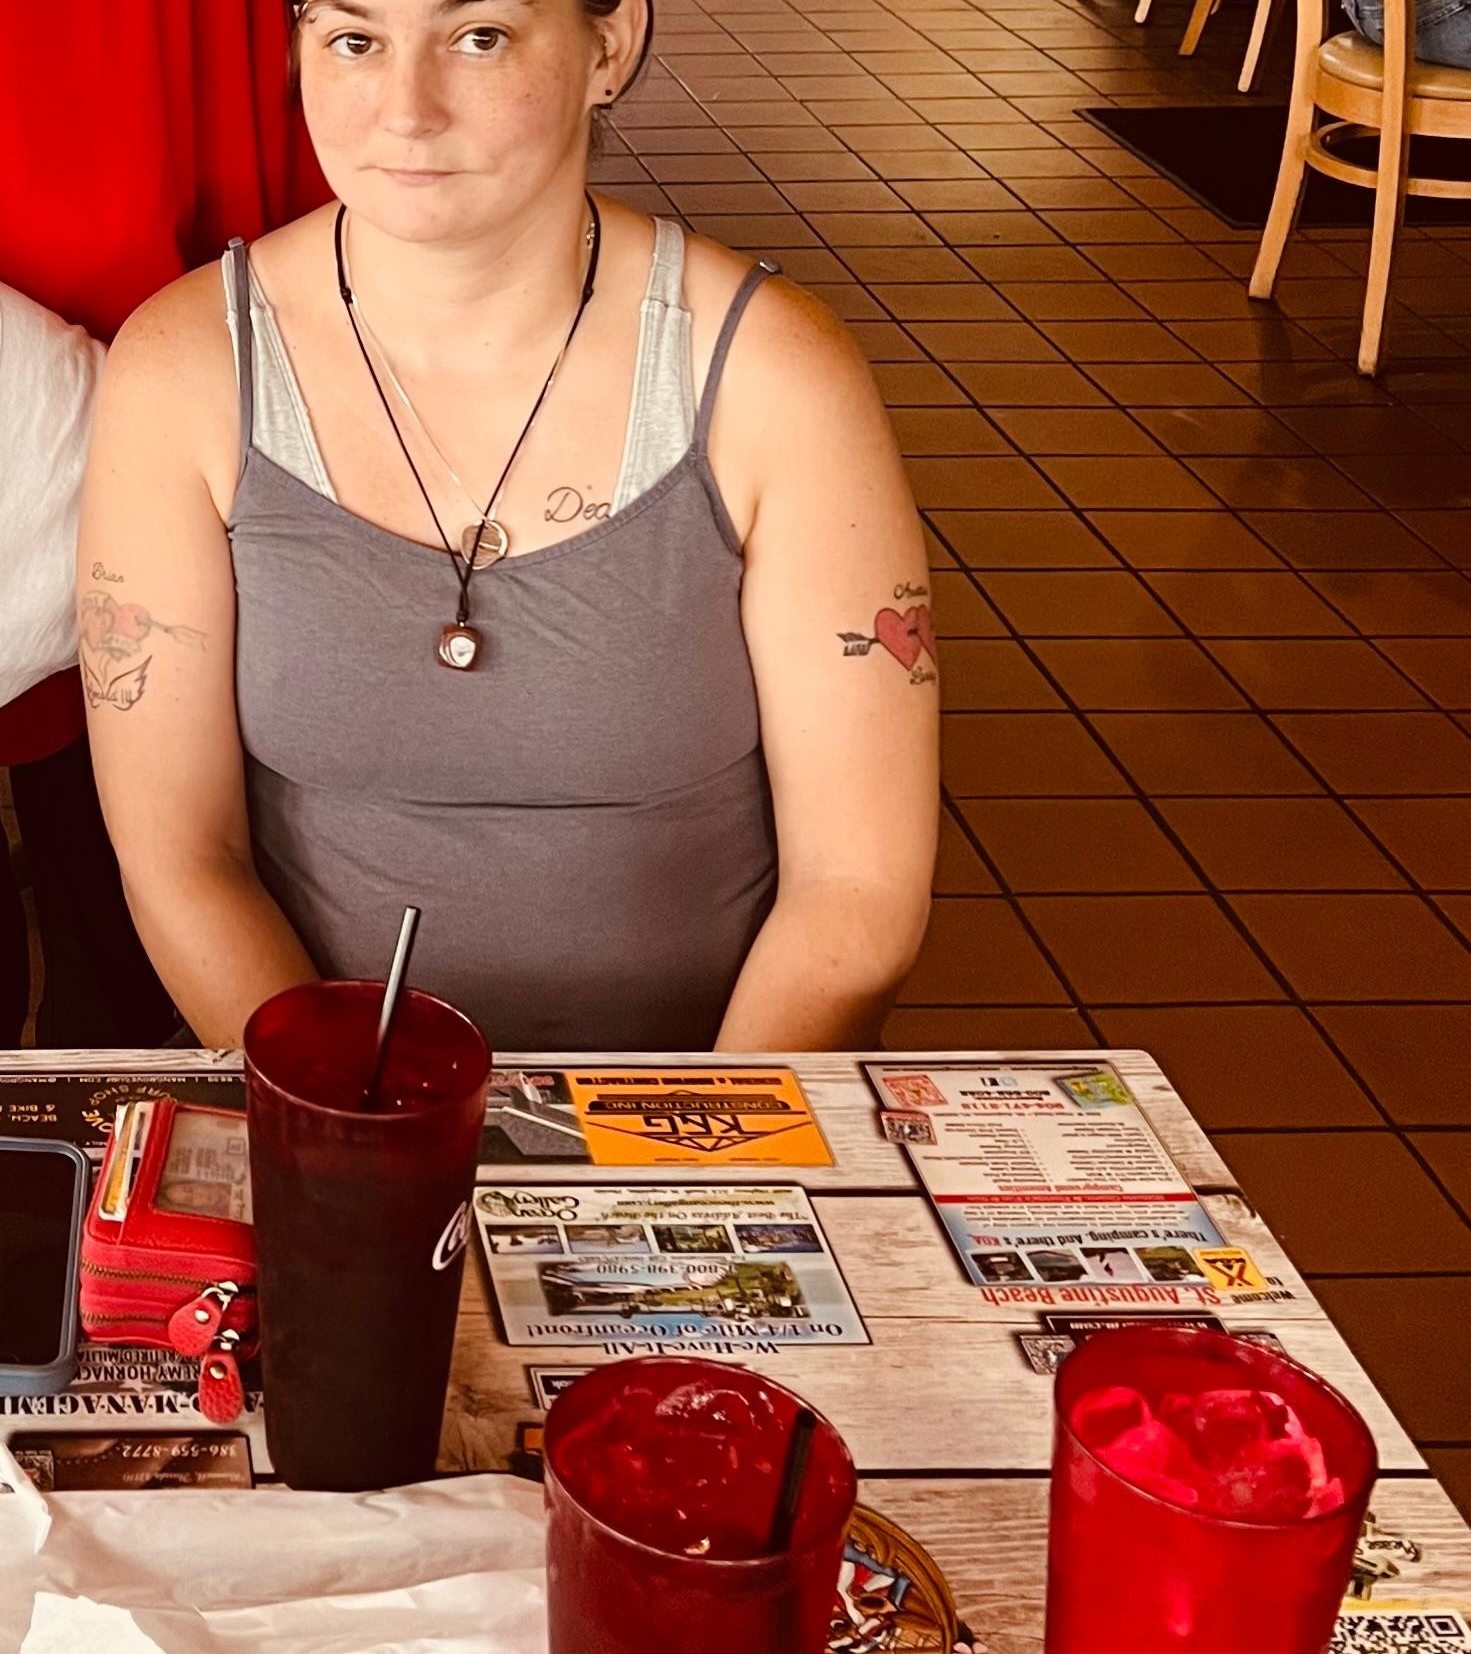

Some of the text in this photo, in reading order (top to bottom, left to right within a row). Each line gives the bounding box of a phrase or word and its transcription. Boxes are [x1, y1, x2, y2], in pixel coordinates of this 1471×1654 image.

[9, 1105, 38, 1113] BIKE
[511, 1191, 580, 1209] Gallery
[511, 1209, 580, 1223] Ocean
[691, 1212, 743, 1222] Address
[1003, 1234, 1055, 1247] there's
[1057, 1234, 1083, 1247] And
[1088, 1228, 1149, 1244] camping.
[1151, 1229, 1208, 1243] There's
[980, 1283, 1222, 1308] St. Augustine Beach
[1231, 1288, 1297, 1304] Welcome
[526, 1323, 666, 1338] Oceanfront!
[675, 1324, 697, 1340] of
[704, 1324, 758, 1338] Mile
[809, 1323, 843, 1337] On
[602, 1342, 780, 1355] We Have It All
[76, 1350, 121, 1363] MILITA
[157, 1366, 201, 1382] REMY
